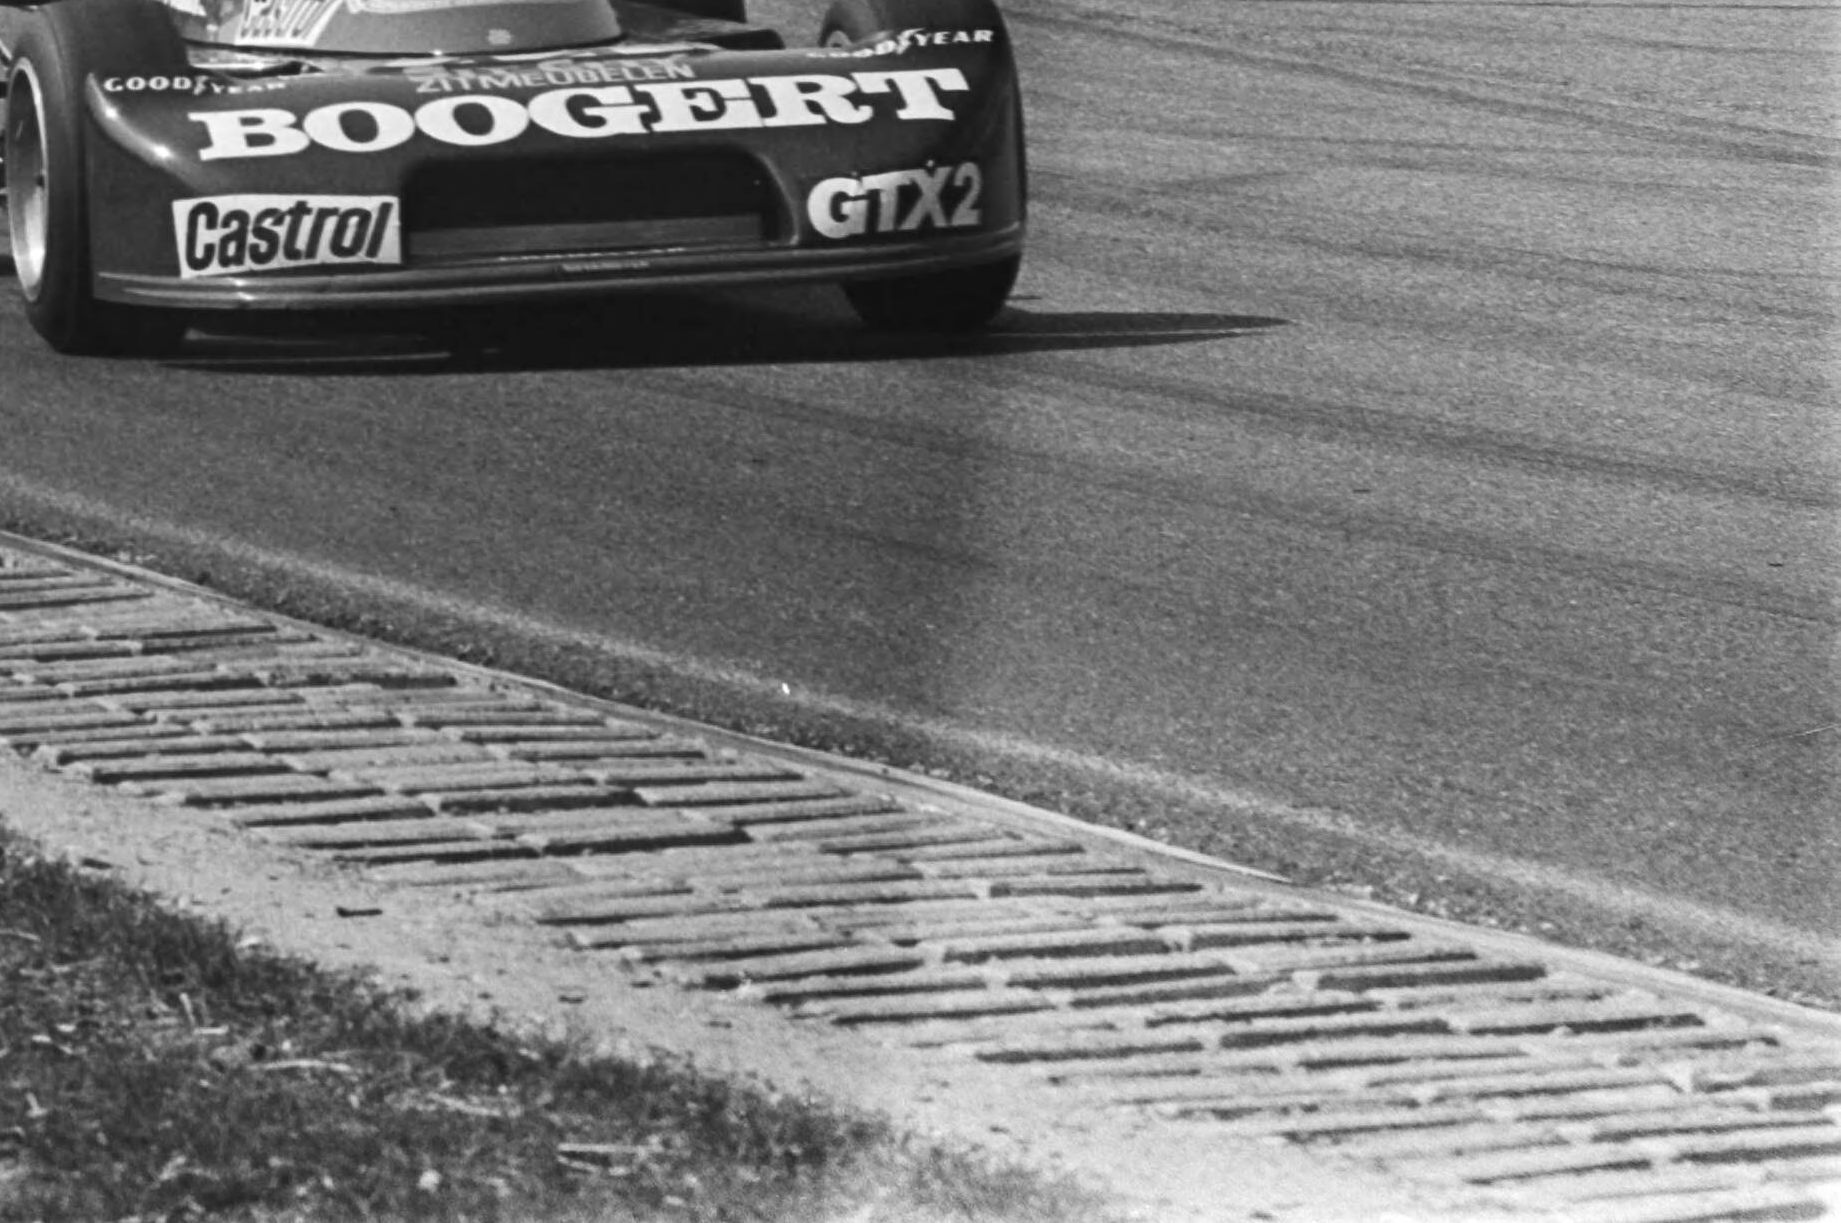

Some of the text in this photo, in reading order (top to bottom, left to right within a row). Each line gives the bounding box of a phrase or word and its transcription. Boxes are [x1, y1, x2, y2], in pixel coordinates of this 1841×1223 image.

[188, 68, 971, 161] BOOGERT
[186, 200, 395, 271] Castrol
[808, 163, 982, 240] GTX2
